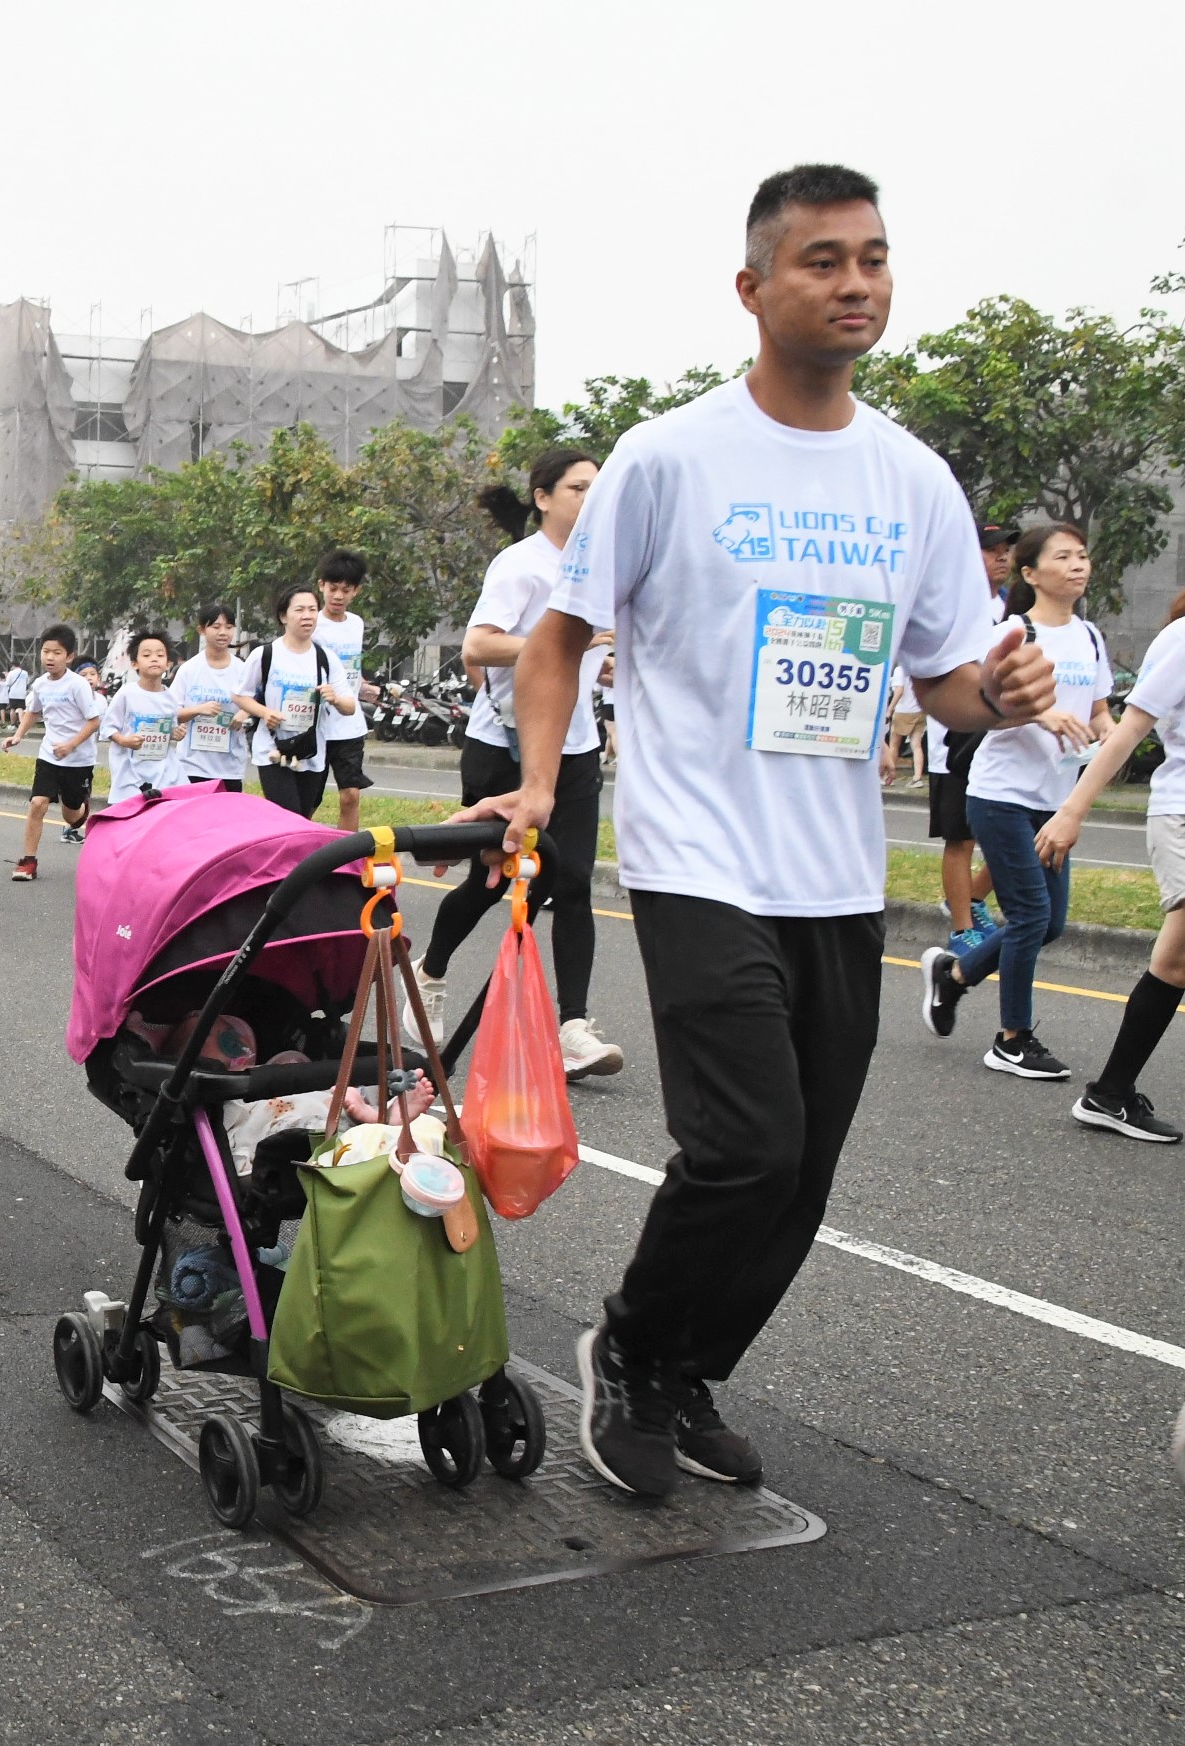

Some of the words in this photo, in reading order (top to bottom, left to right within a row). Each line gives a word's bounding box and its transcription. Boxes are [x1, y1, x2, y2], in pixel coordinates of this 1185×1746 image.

[779, 510, 855, 533] LIONS
[775, 658, 871, 693] 30355
[288, 703, 315, 713] 5021
[786, 691, 852, 721] 林昭睿
[197, 726, 227, 735] 50216
